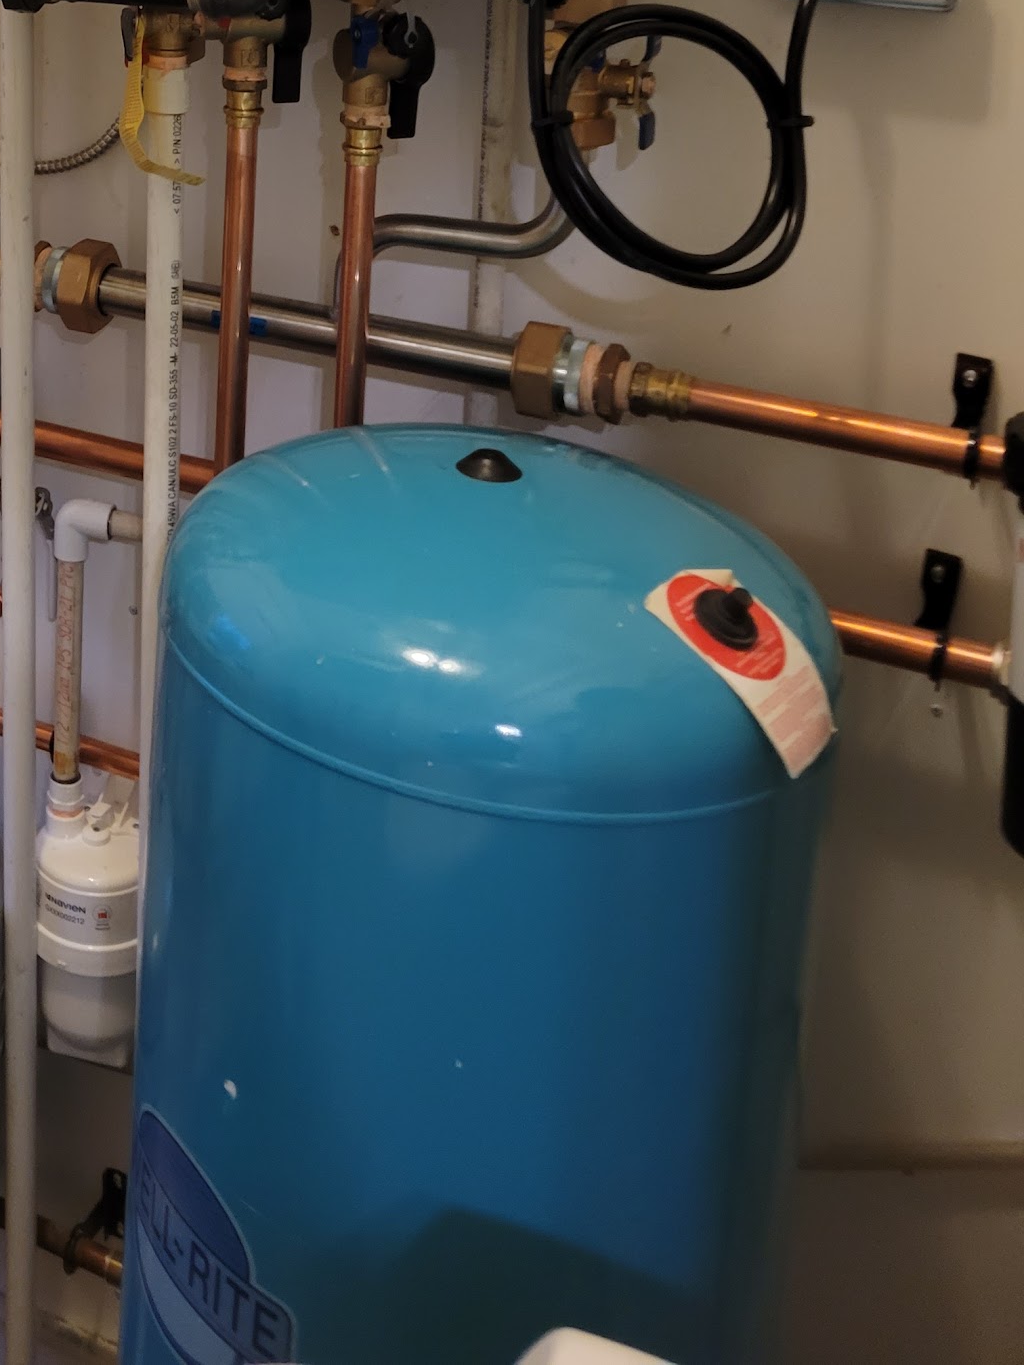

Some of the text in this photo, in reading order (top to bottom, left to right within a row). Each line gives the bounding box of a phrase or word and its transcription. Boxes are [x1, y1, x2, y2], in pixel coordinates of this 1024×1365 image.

[170, 310, 180, 348] 22-05-02
[169, 369, 178, 400] SD-355
[169, 402, 178, 427] FS-10
[139, 1160, 279, 1363] ELL-RITE
